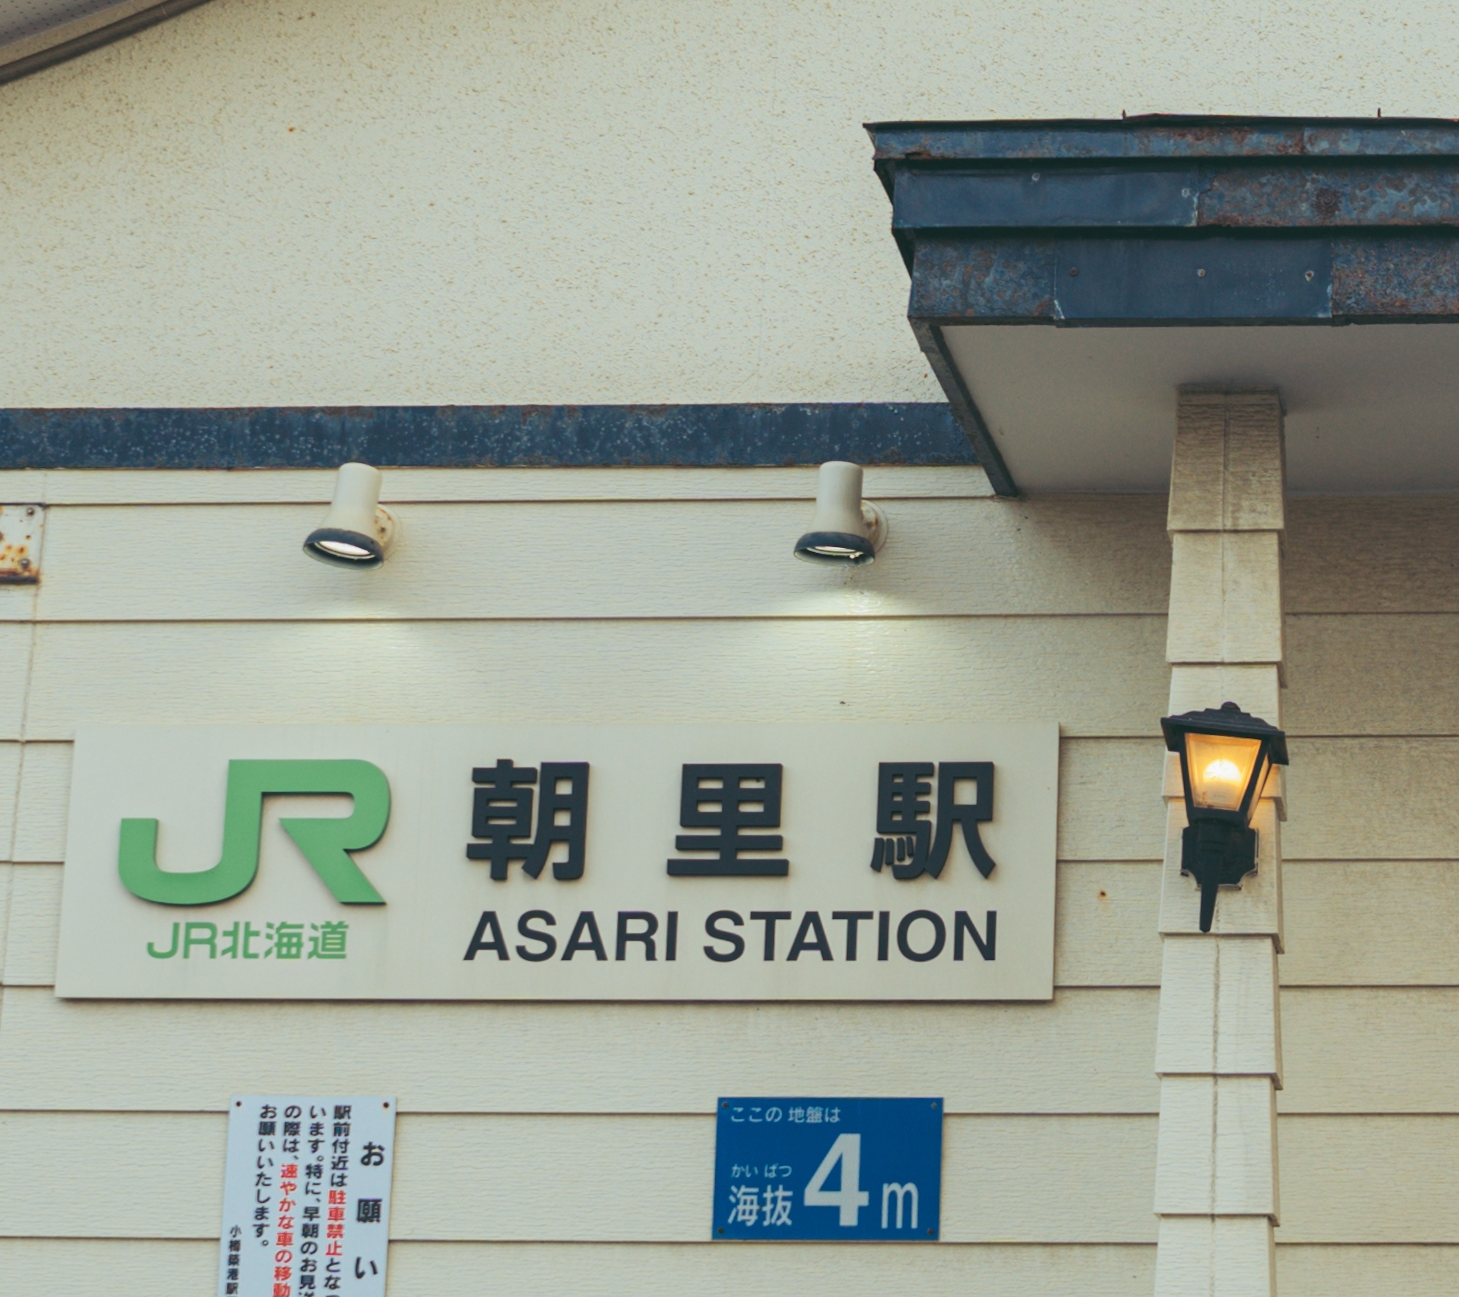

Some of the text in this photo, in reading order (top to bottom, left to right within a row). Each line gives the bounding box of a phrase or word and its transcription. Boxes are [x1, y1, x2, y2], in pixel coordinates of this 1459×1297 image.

[118, 759, 390, 906] JR
[466, 759, 997, 881] 朝里駅
[146, 919, 350, 960] JR北海道
[463, 908, 997, 963] ASARI STATION
[730, 1106, 842, 1124] ここの 地盤は
[252, 1104, 277, 1248] お願いいたします。
[354, 1141, 385, 1280] お願い
[727, 1133, 919, 1230] 海抜 4 m
[731, 1163, 792, 1179] かい ばつ
